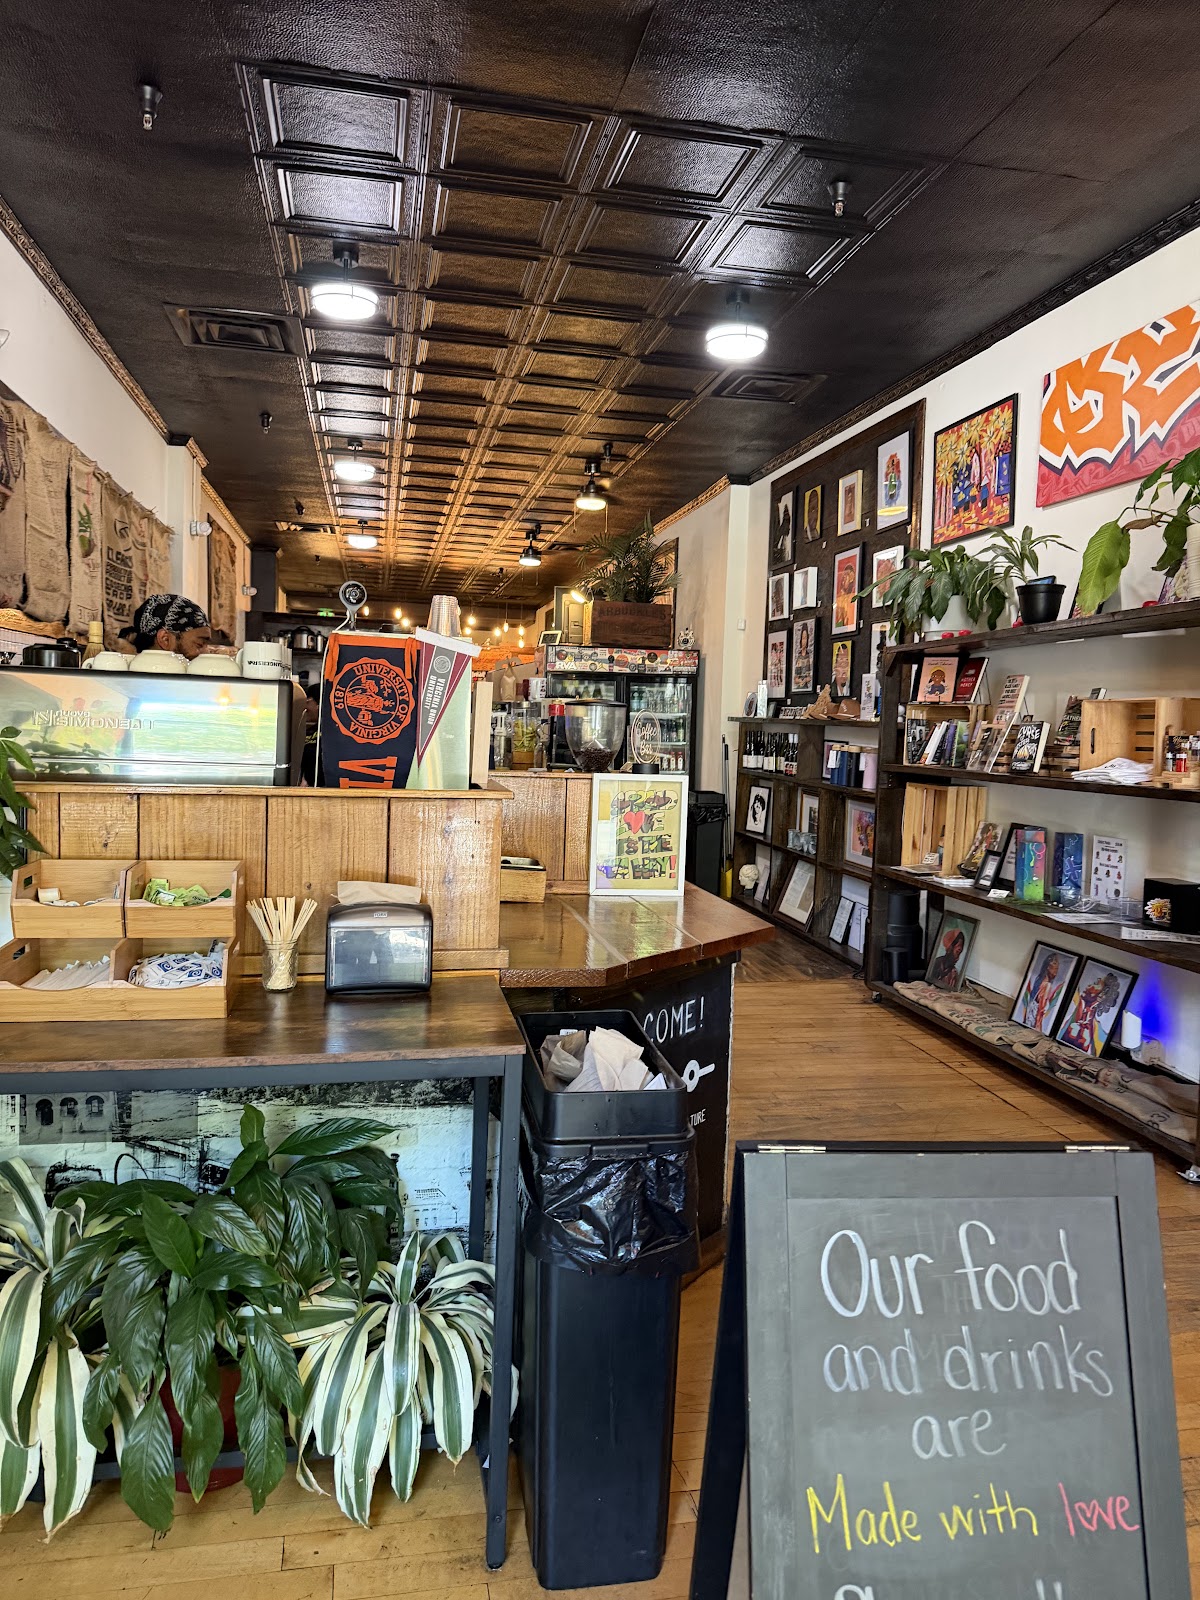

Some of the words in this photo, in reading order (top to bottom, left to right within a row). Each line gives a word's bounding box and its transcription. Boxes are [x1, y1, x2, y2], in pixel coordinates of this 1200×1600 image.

[555, 661, 578, 670] RVA
[353, 663, 410, 702] UNIVERSITY
[424, 675, 438, 709] UNIVERSITY
[431, 678, 446, 708] VIRGINIA
[334, 685, 346, 710] 1819
[55, 709, 91, 718] nuova
[397, 703, 409, 722] OF
[349, 720, 401, 739] VIRGINIA
[636, 721, 657, 741] Coffee
[639, 740, 654, 756] Bar
[638, 833, 673, 855] THE
[630, 854, 677, 879] WAY!
[643, 996, 705, 1044] COME!
[690, 1108, 707, 1127] TURE
[820, 1229, 934, 1318] Our
[954, 1220, 1081, 1316] food
[823, 1328, 922, 1395] and
[944, 1324, 1113, 1397] drinks
[912, 1409, 1006, 1460] are
[806, 1473, 922, 1553] Made
[939, 1482, 1038, 1540] with
[1058, 1482, 1140, 1537] love
